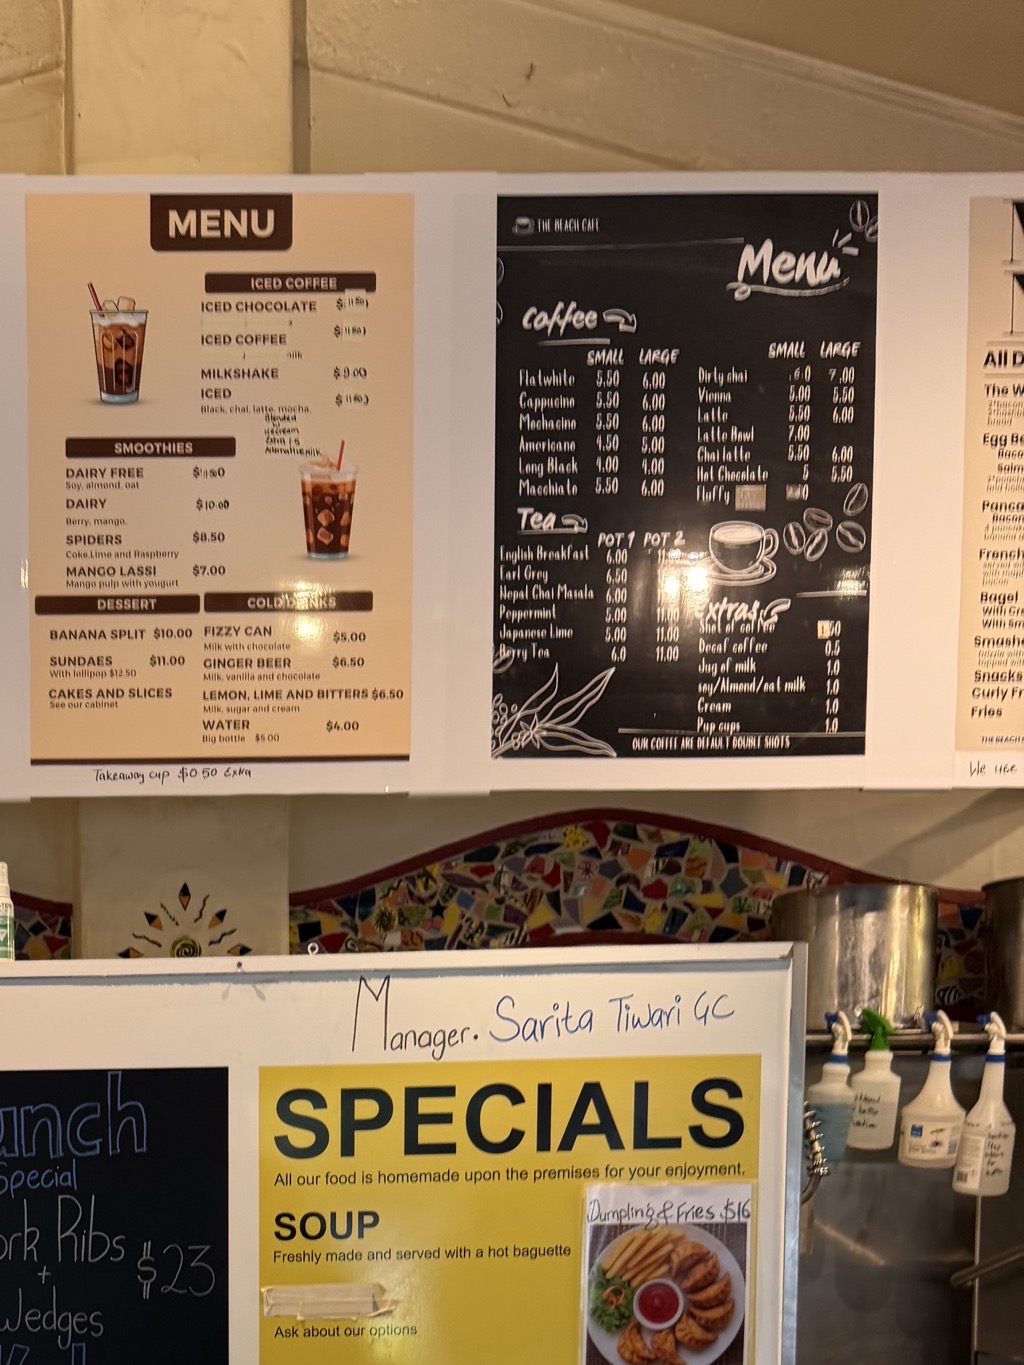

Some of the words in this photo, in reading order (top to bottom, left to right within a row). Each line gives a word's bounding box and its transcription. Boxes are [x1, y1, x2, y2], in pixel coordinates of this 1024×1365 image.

[168, 209, 275, 239] MENU
[738, 239, 840, 287] Menu
[251, 278, 282, 290] ICED
[285, 277, 337, 289] COFFEE
[587, 350, 624, 366] SMALL
[639, 350, 679, 365] LARGE
[114, 442, 193, 455] SMOOTHIES
[97, 599, 157, 611] DESSERT
[50, 629, 107, 640] BANANA
[110, 629, 146, 640] SPLIT
[153, 627, 192, 640] $10.00
[202, 689, 250, 702] LEMON,
[253, 689, 283, 700] LIME
[287, 689, 314, 700] AND
[317, 689, 369, 700] BITTERS
[372, 688, 404, 701] $6.50
[94, 768, 145, 784] Takeaway
[149, 771, 170, 785] cup
[489, 995, 593, 1043] Sarita
[609, 994, 682, 1033] Tiwari
[274, 1078, 745, 1159] SPECIALS
[274, 1172, 291, 1186] All
[295, 1175, 321, 1185] our
[325, 1172, 357, 1184] food
[361, 1172, 372, 1184] is
[378, 1169, 459, 1184] homemade
[464, 1170, 500, 1185] upon
[506, 1167, 528, 1180] the
[533, 1166, 599, 1183] premises
[604, 1164, 624, 1179] for
[628, 1166, 661, 1181] your
[676, 1201, 715, 1221] Fries
[720, 1198, 750, 1221] $16
[58, 1195, 125, 1262] Ribs
[274, 1211, 379, 1241] SOUP
[273, 1249, 321, 1265] Freshly
[326, 1248, 362, 1261] made
[367, 1247, 391, 1261] and
[396, 1246, 440, 1261] served
[445, 1246, 471, 1259] with
[476, 1249, 483, 1258] a
[488, 1245, 509, 1258] hot
[513, 1244, 571, 1261] baguette
[138, 1240, 215, 1299] $23
[274, 1325, 298, 1338] Ask
[303, 1324, 340, 1337] about
[344, 1327, 365, 1337] our
[369, 1323, 417, 1340] options
